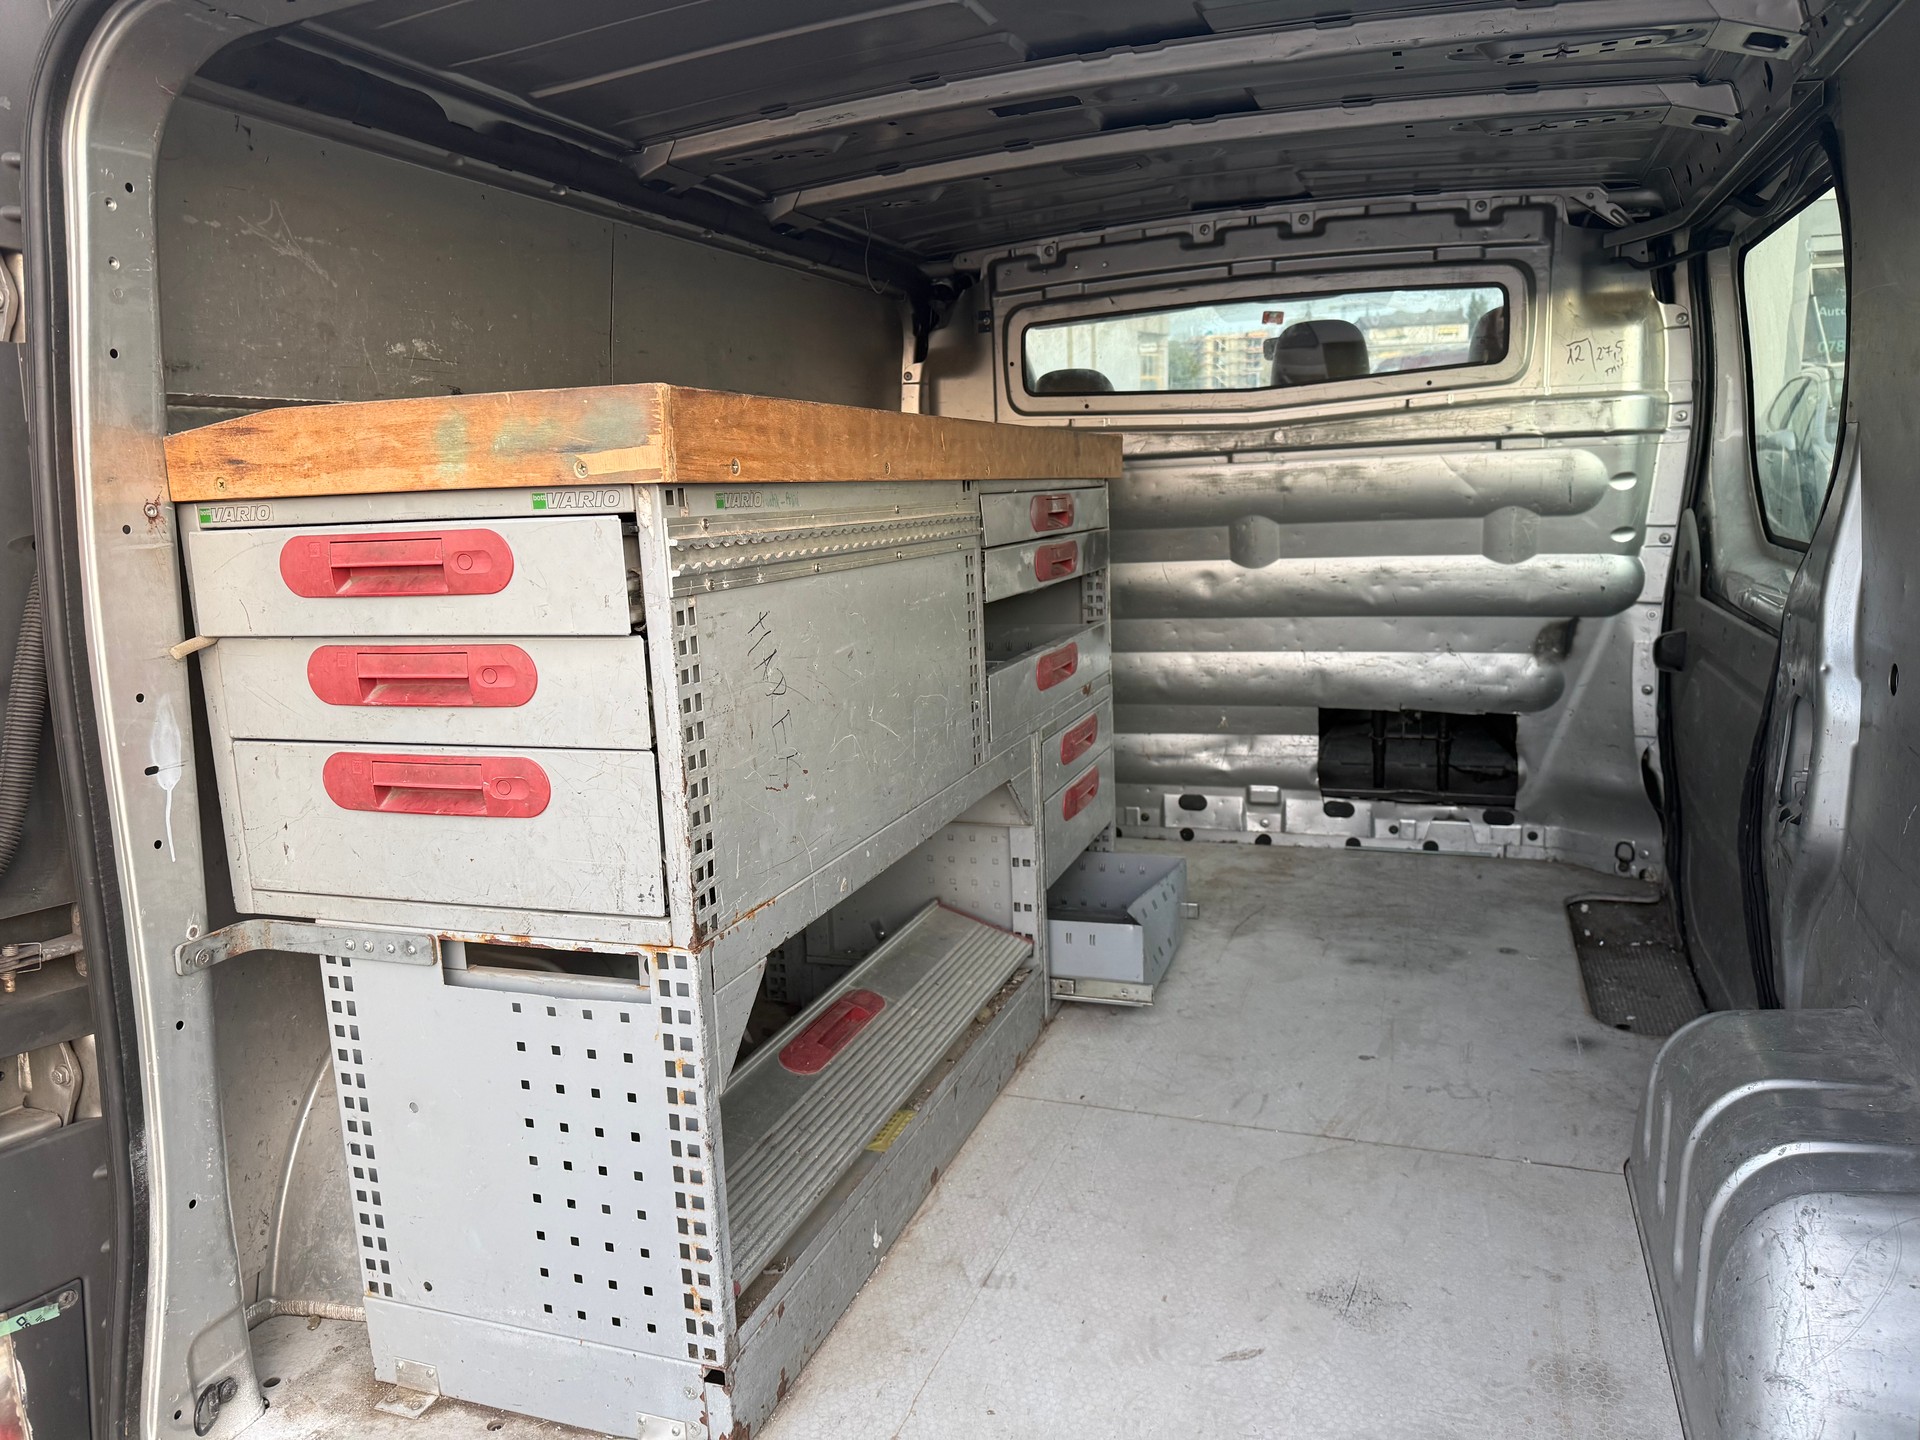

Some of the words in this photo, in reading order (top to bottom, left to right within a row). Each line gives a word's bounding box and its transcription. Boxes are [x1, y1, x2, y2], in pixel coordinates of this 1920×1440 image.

[546, 490, 620, 509] VARIO
[724, 492, 762, 509] VARIO
[210, 504, 271, 523] VARIO
